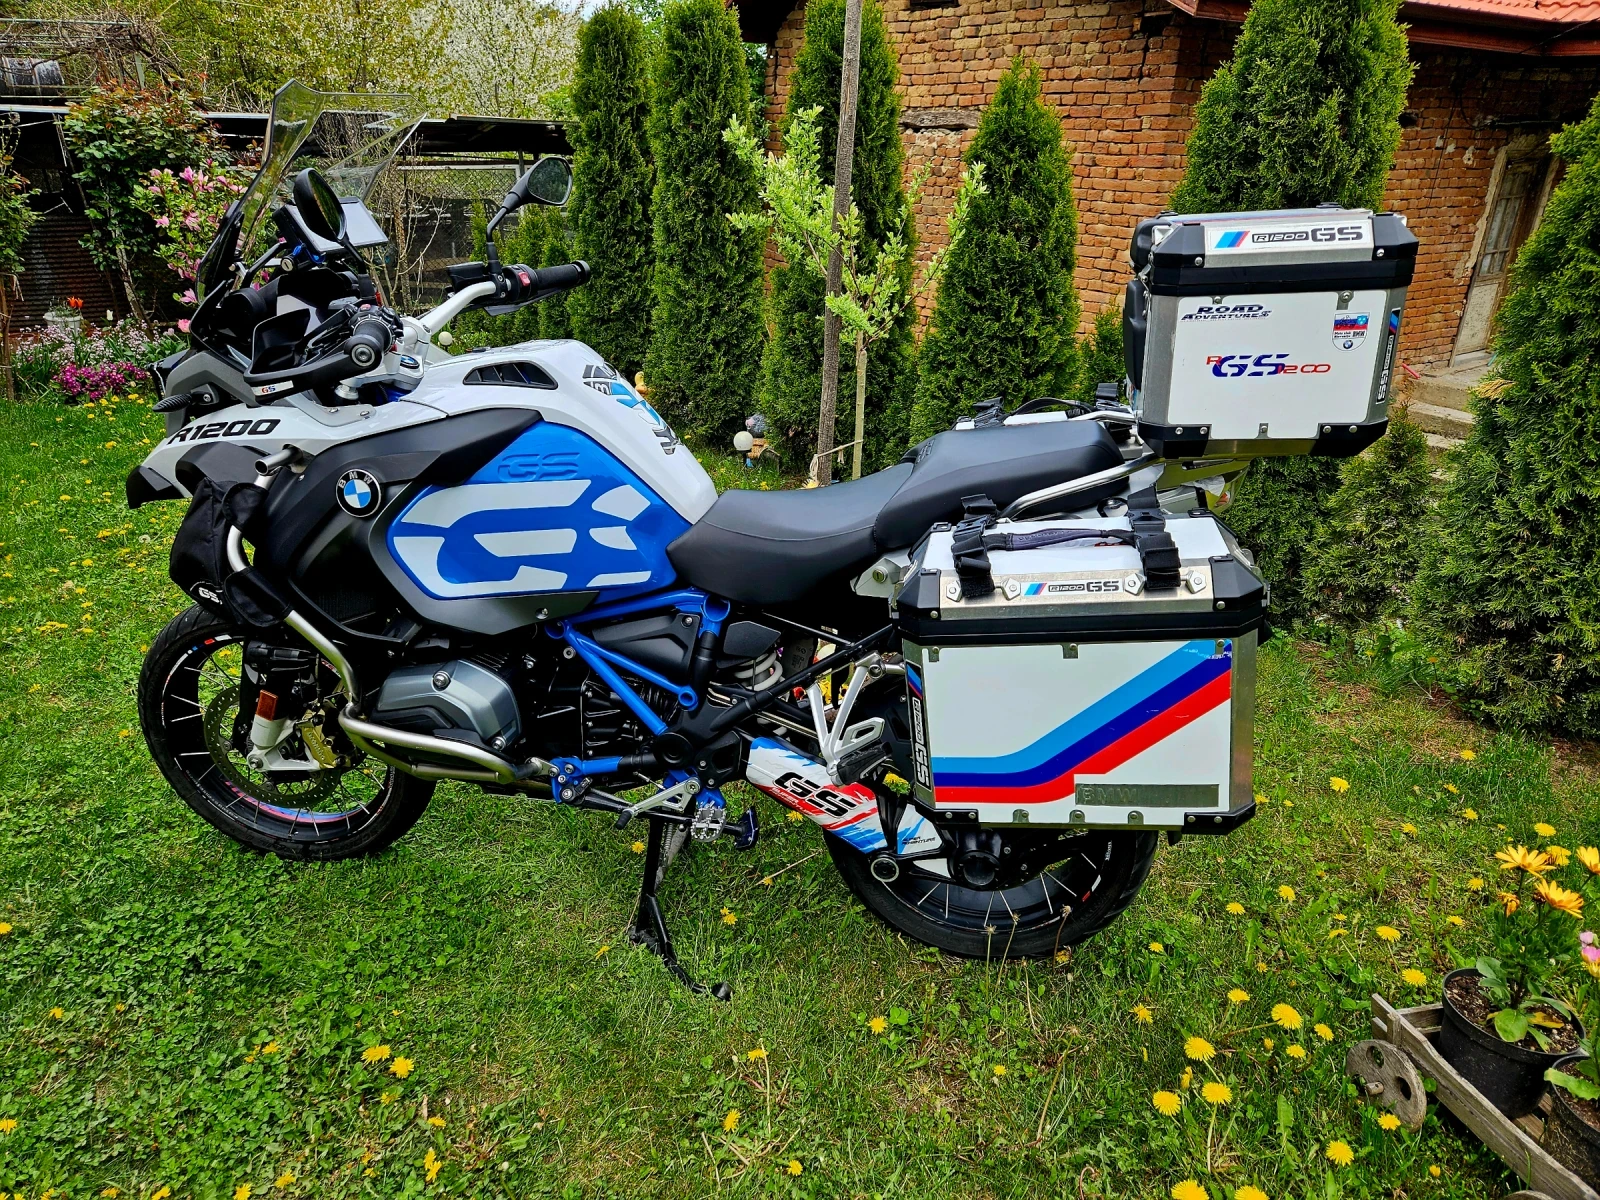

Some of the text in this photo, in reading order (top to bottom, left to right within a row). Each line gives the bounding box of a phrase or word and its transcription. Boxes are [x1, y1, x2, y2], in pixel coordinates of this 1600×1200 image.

[1254, 226, 1363, 242] R1200 GS
[1197, 304, 1264, 314] ROAD
[1212, 354, 1290, 377] GS
[261, 385, 276, 393] GS
[167, 419, 281, 445] R1200
[498, 452, 580, 482] GS
[338, 471, 373, 489] BMW
[1049, 580, 1120, 592] R1200 GS
[199, 587, 219, 603] GS
[912, 697, 930, 786] R1200 GS
[773, 771, 858, 818] GS
[1083, 788, 1137, 804] BMW
